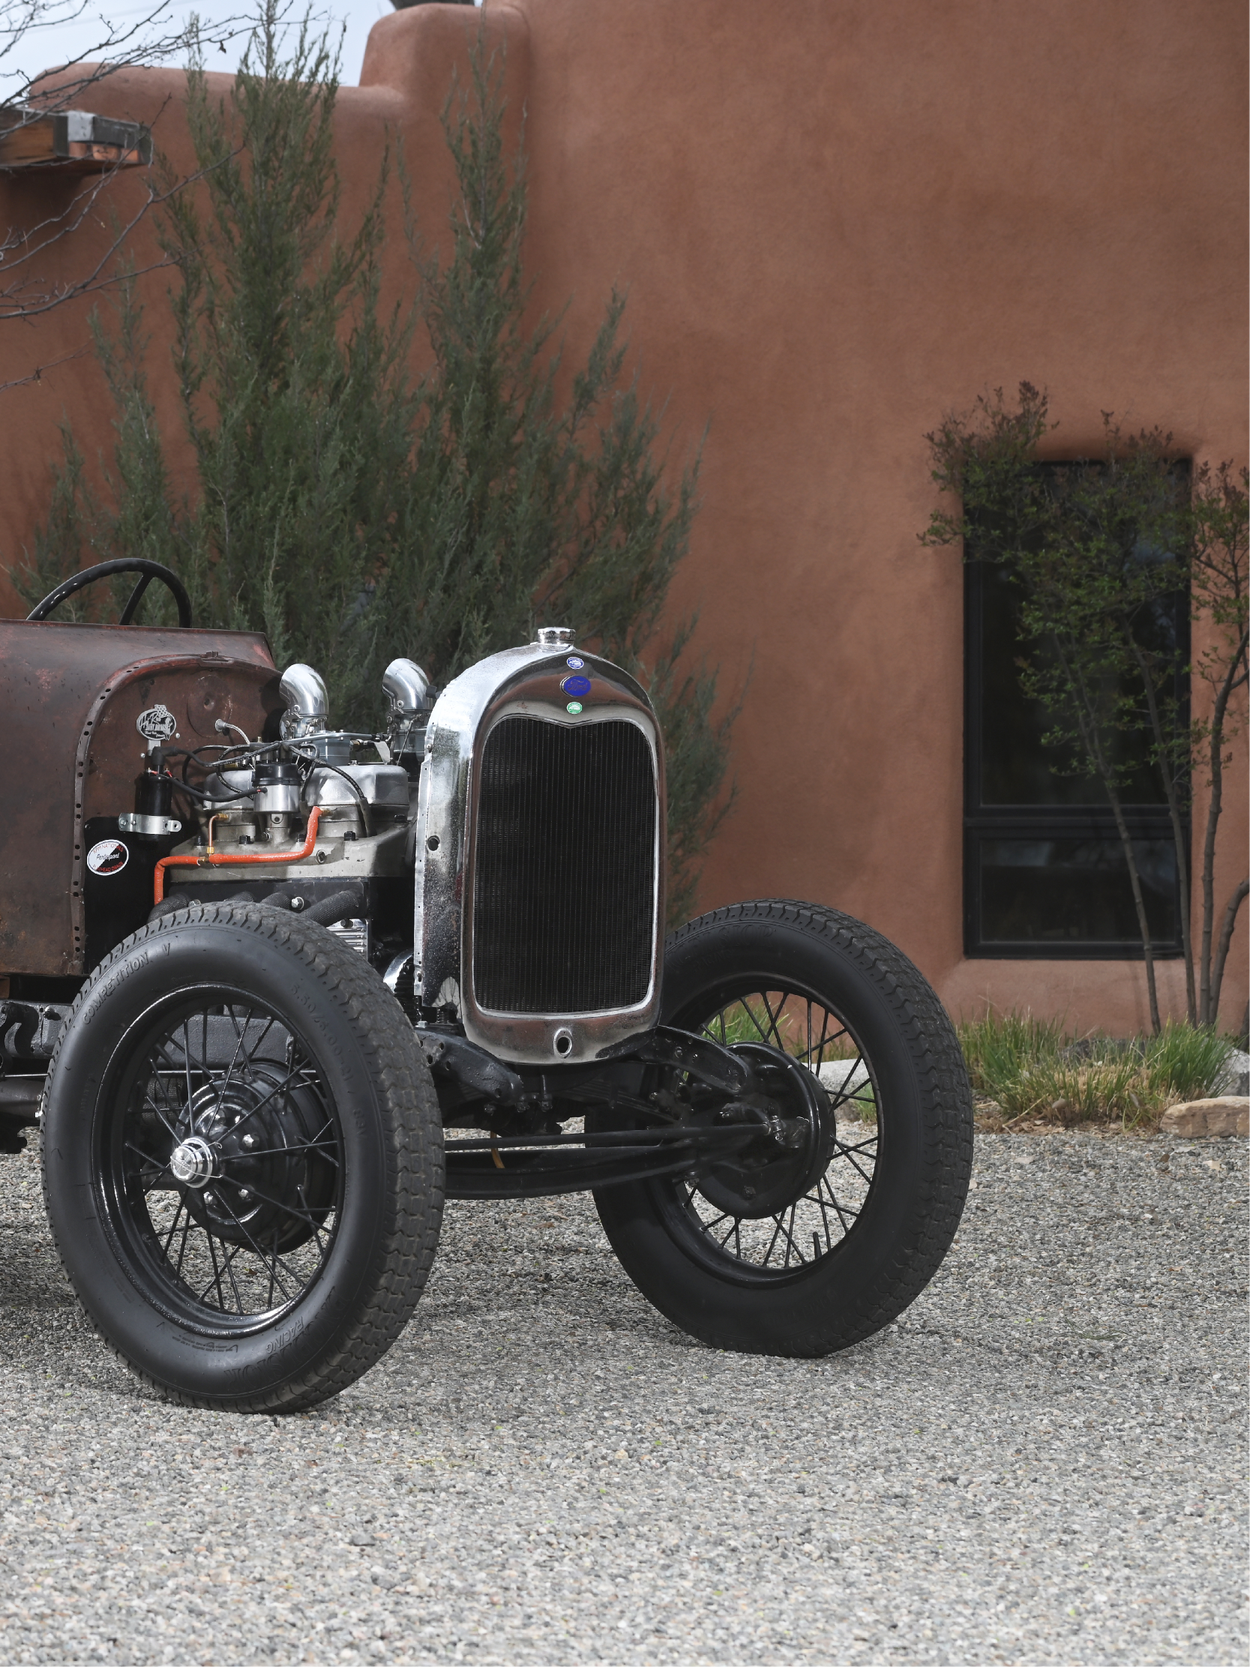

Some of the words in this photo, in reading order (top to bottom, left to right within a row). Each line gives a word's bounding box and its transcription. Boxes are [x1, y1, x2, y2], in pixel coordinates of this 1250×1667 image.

[567, 678, 588, 692] Ford
[82, 950, 150, 1025] COMPETITION
[265, 1315, 305, 1354] RACING
